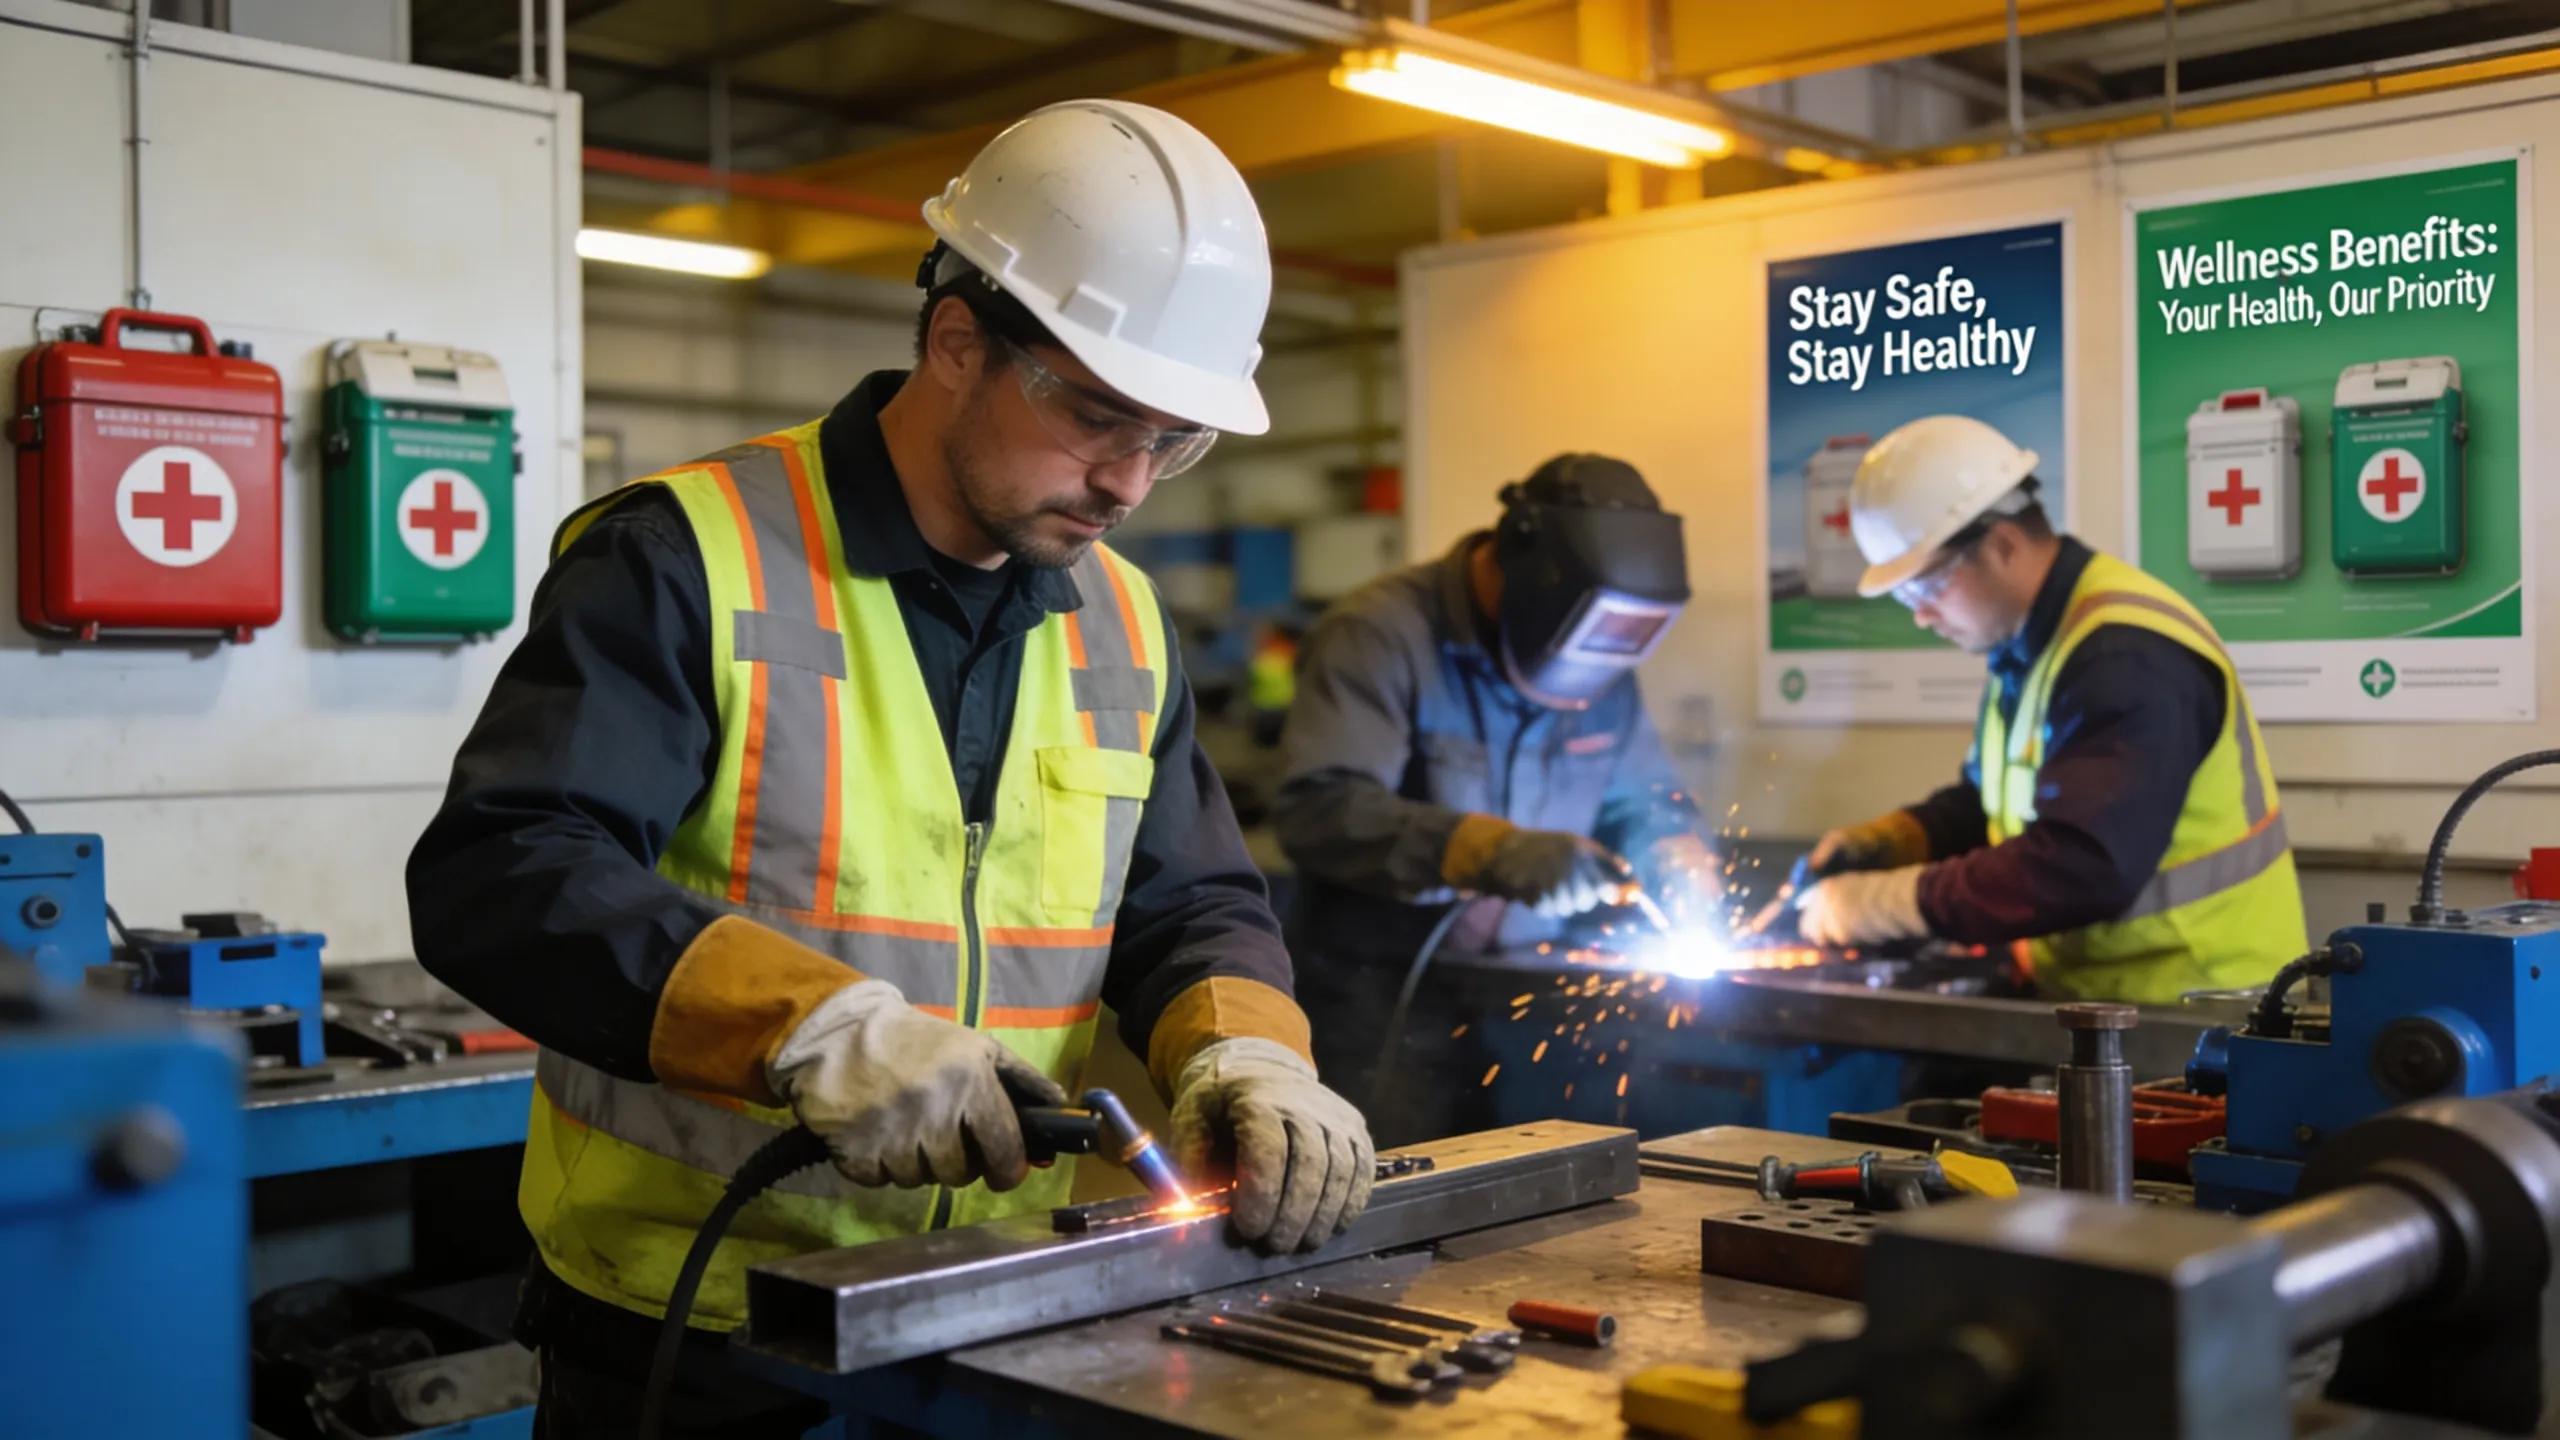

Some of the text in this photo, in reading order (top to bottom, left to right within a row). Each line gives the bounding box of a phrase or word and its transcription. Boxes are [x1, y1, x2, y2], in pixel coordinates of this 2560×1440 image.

[2157, 215, 2498, 290] Wellness Benefits:
[1789, 266, 1986, 335] Stay Safe,
[2158, 268, 2495, 335] Your Health, Our Priority
[1788, 317, 2036, 391] Stay Healthy
